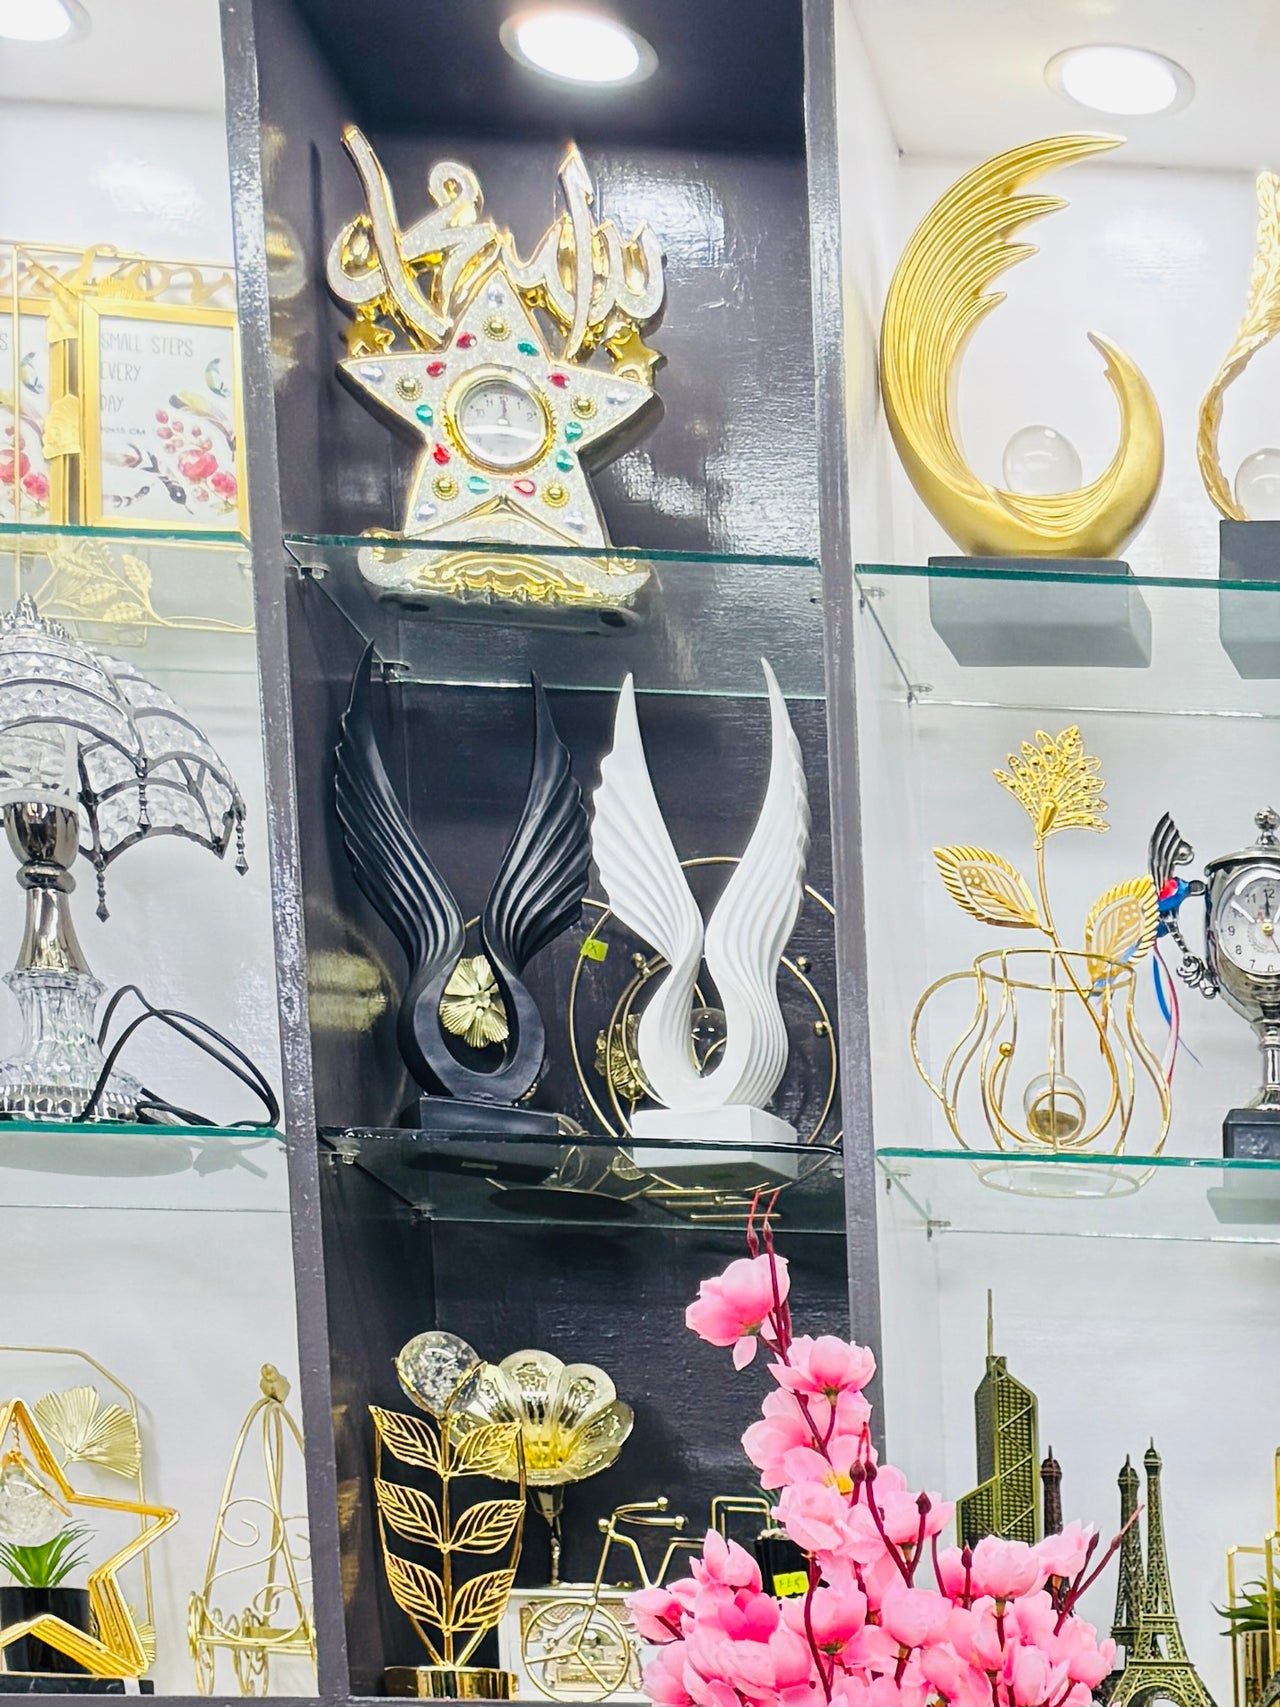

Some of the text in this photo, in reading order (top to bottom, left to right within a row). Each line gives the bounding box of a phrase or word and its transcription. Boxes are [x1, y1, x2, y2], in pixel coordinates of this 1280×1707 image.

[100, 332, 194, 357] SMALL STEPS
[100, 361, 142, 382] EVERY
[100, 394, 125, 413] DAY
[1228, 925, 1235, 936] 9
[1235, 945, 1242, 955] 8
[1249, 960, 1256, 968] 7
